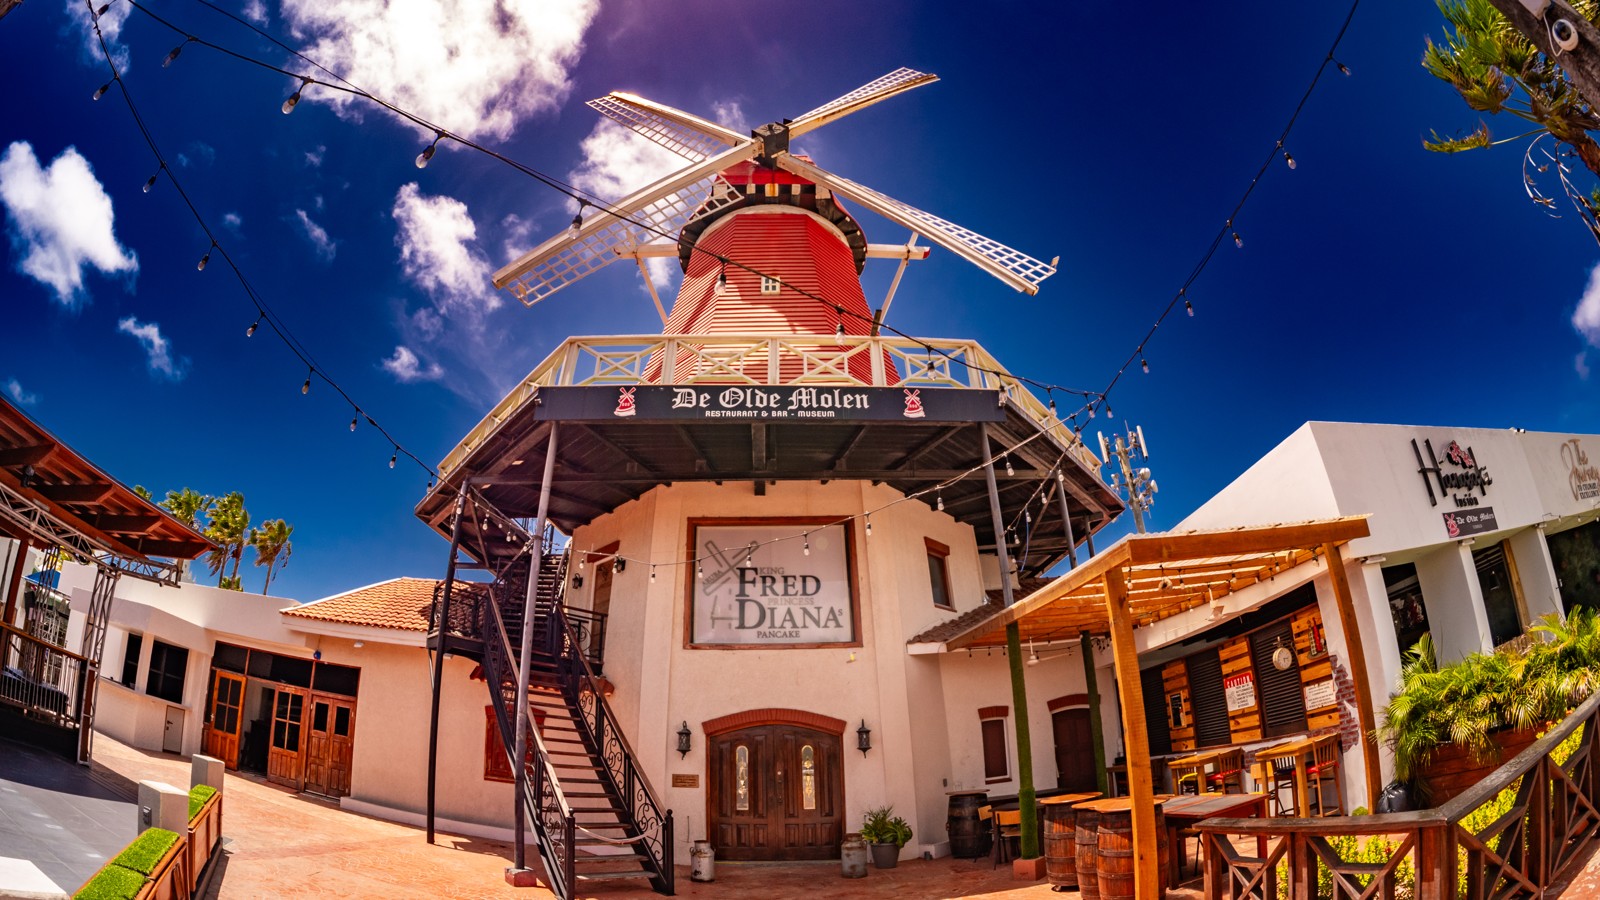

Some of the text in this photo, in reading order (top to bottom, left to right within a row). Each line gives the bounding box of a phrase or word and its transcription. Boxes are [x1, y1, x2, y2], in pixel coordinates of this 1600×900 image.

[672, 387, 870, 410] De Olde Molen
[705, 410, 758, 418] RESTAURANT
[761, 410, 769, 418] &
[771, 410, 788, 418] BAR
[797, 410, 835, 418] MUSEUM
[759, 567, 785, 575] KING
[735, 567, 821, 597] FRED
[767, 597, 815, 606] PRINCESS
[757, 630, 800, 638] PANCAKE
